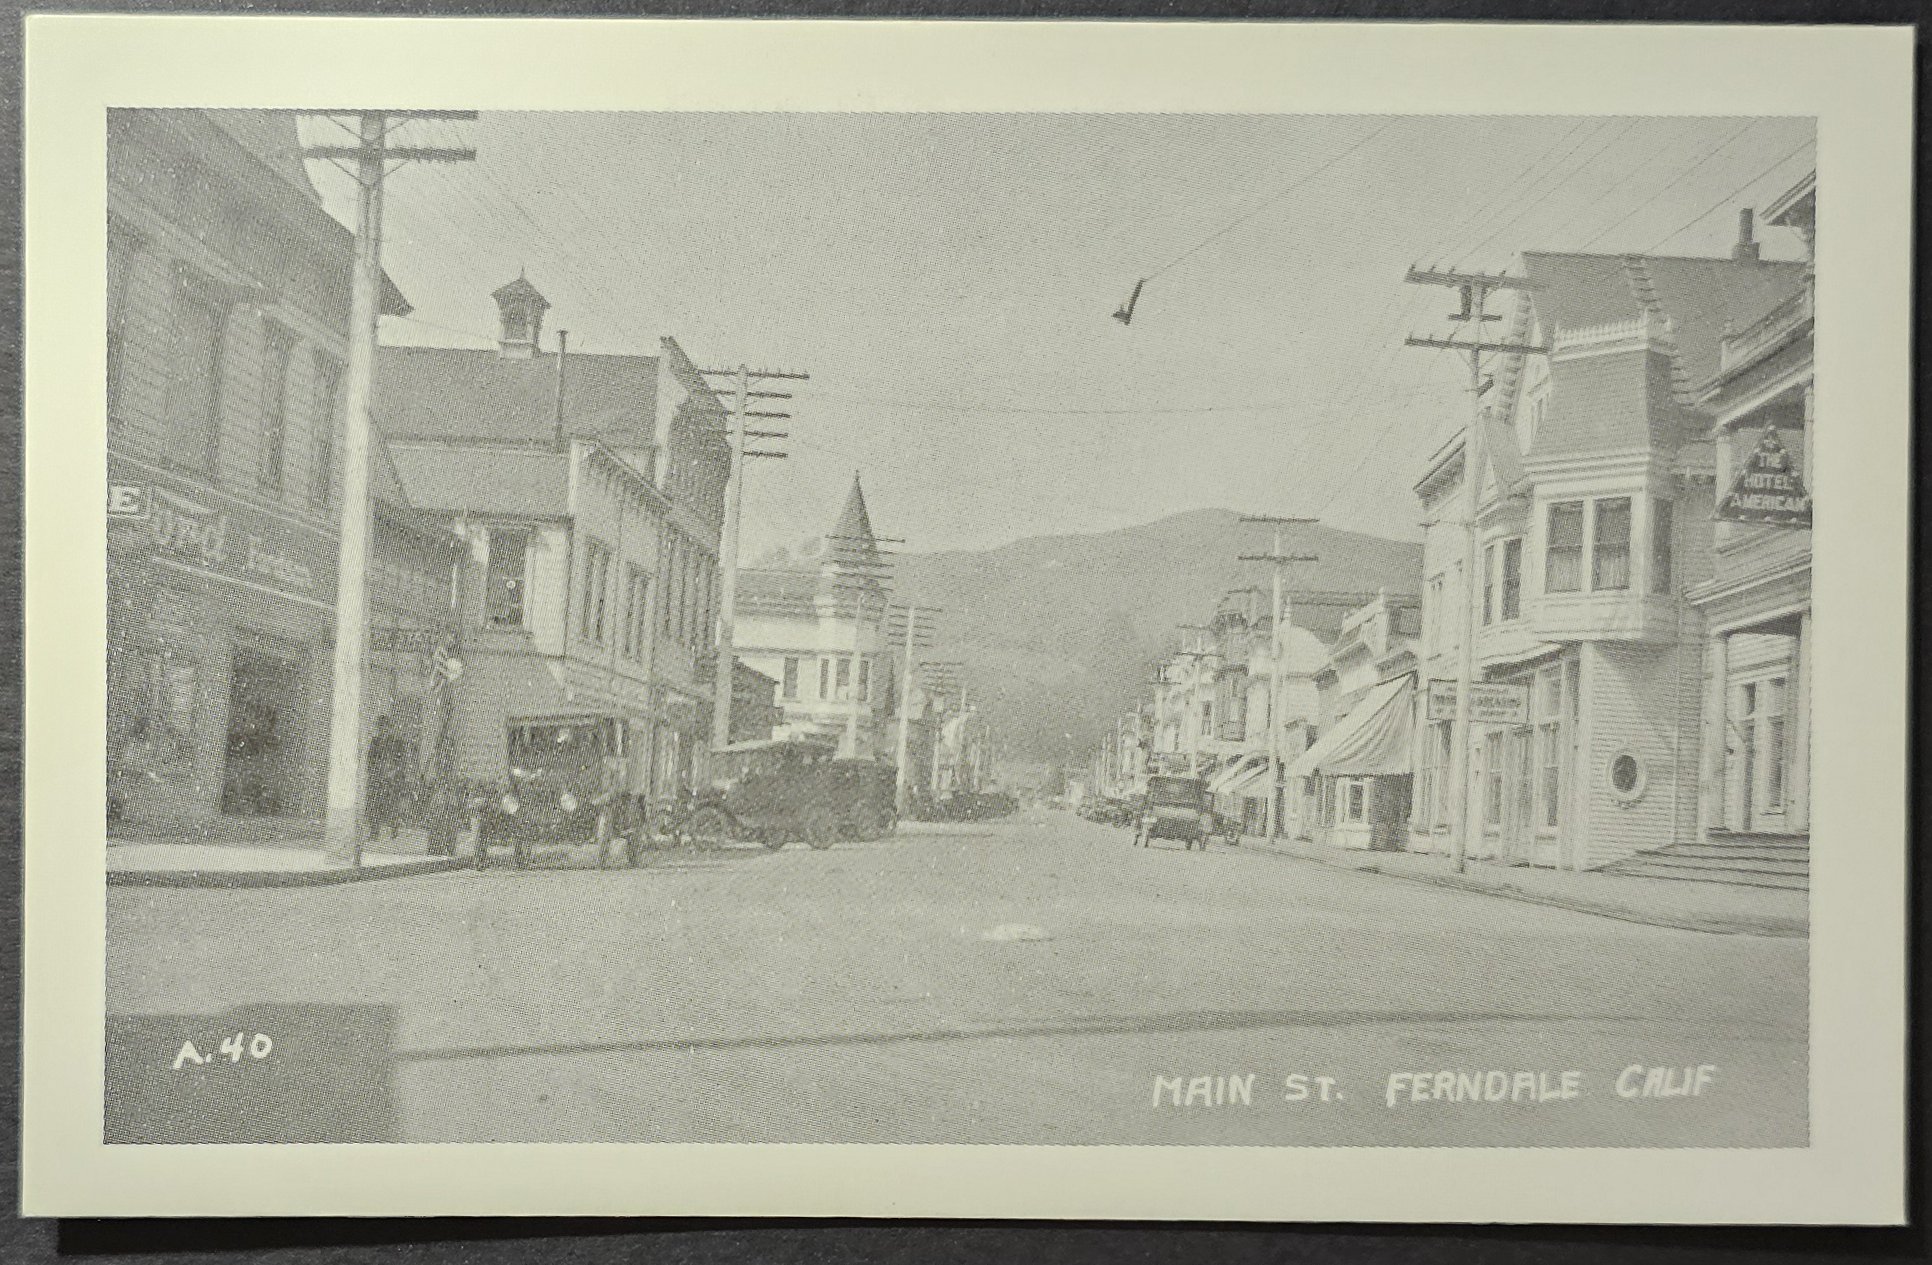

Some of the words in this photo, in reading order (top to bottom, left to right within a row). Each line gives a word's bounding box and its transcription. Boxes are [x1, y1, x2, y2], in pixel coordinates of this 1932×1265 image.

[1744, 473, 1794, 490] HOTEL
[108, 485, 141, 513] E
[152, 487, 228, 562] Ford
